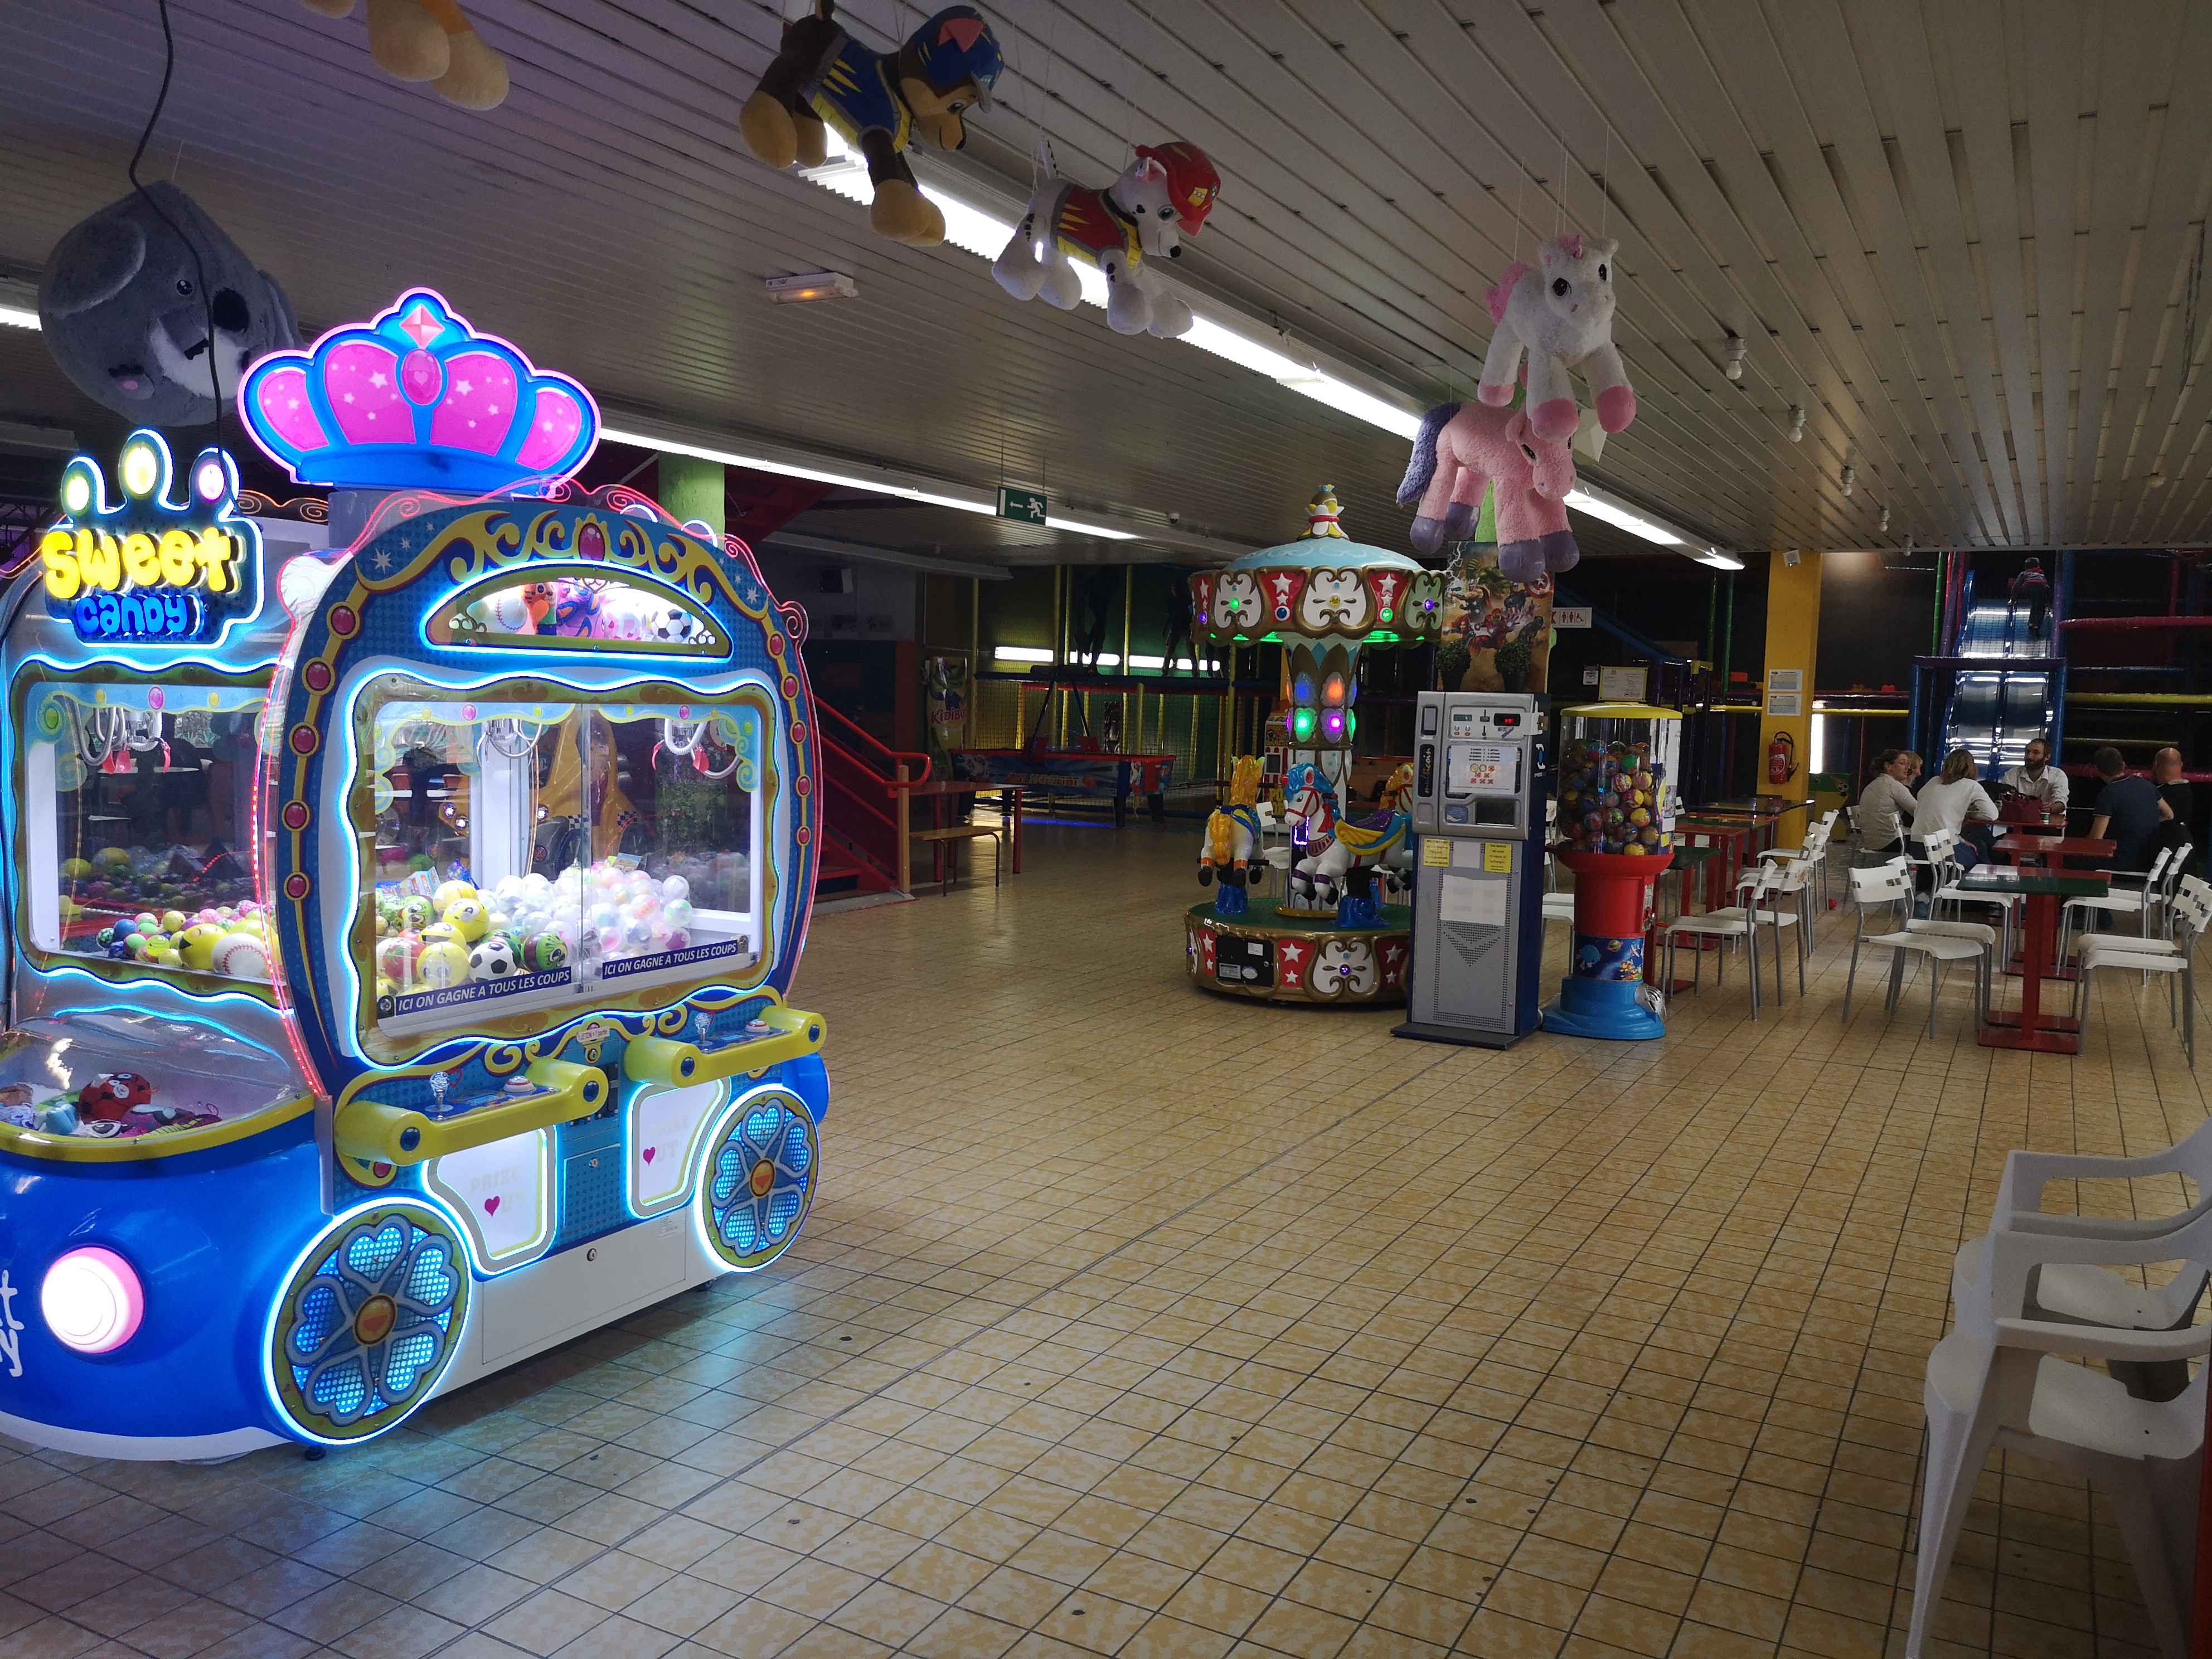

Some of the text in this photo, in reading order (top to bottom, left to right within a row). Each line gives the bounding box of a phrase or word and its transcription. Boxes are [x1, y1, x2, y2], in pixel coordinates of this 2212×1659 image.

[604, 943, 737, 976] ICI ON GAGNE A TOUS LES COUPS
[398, 970, 570, 1012] ICI ON GAGNE A TOUS LES COUPS
